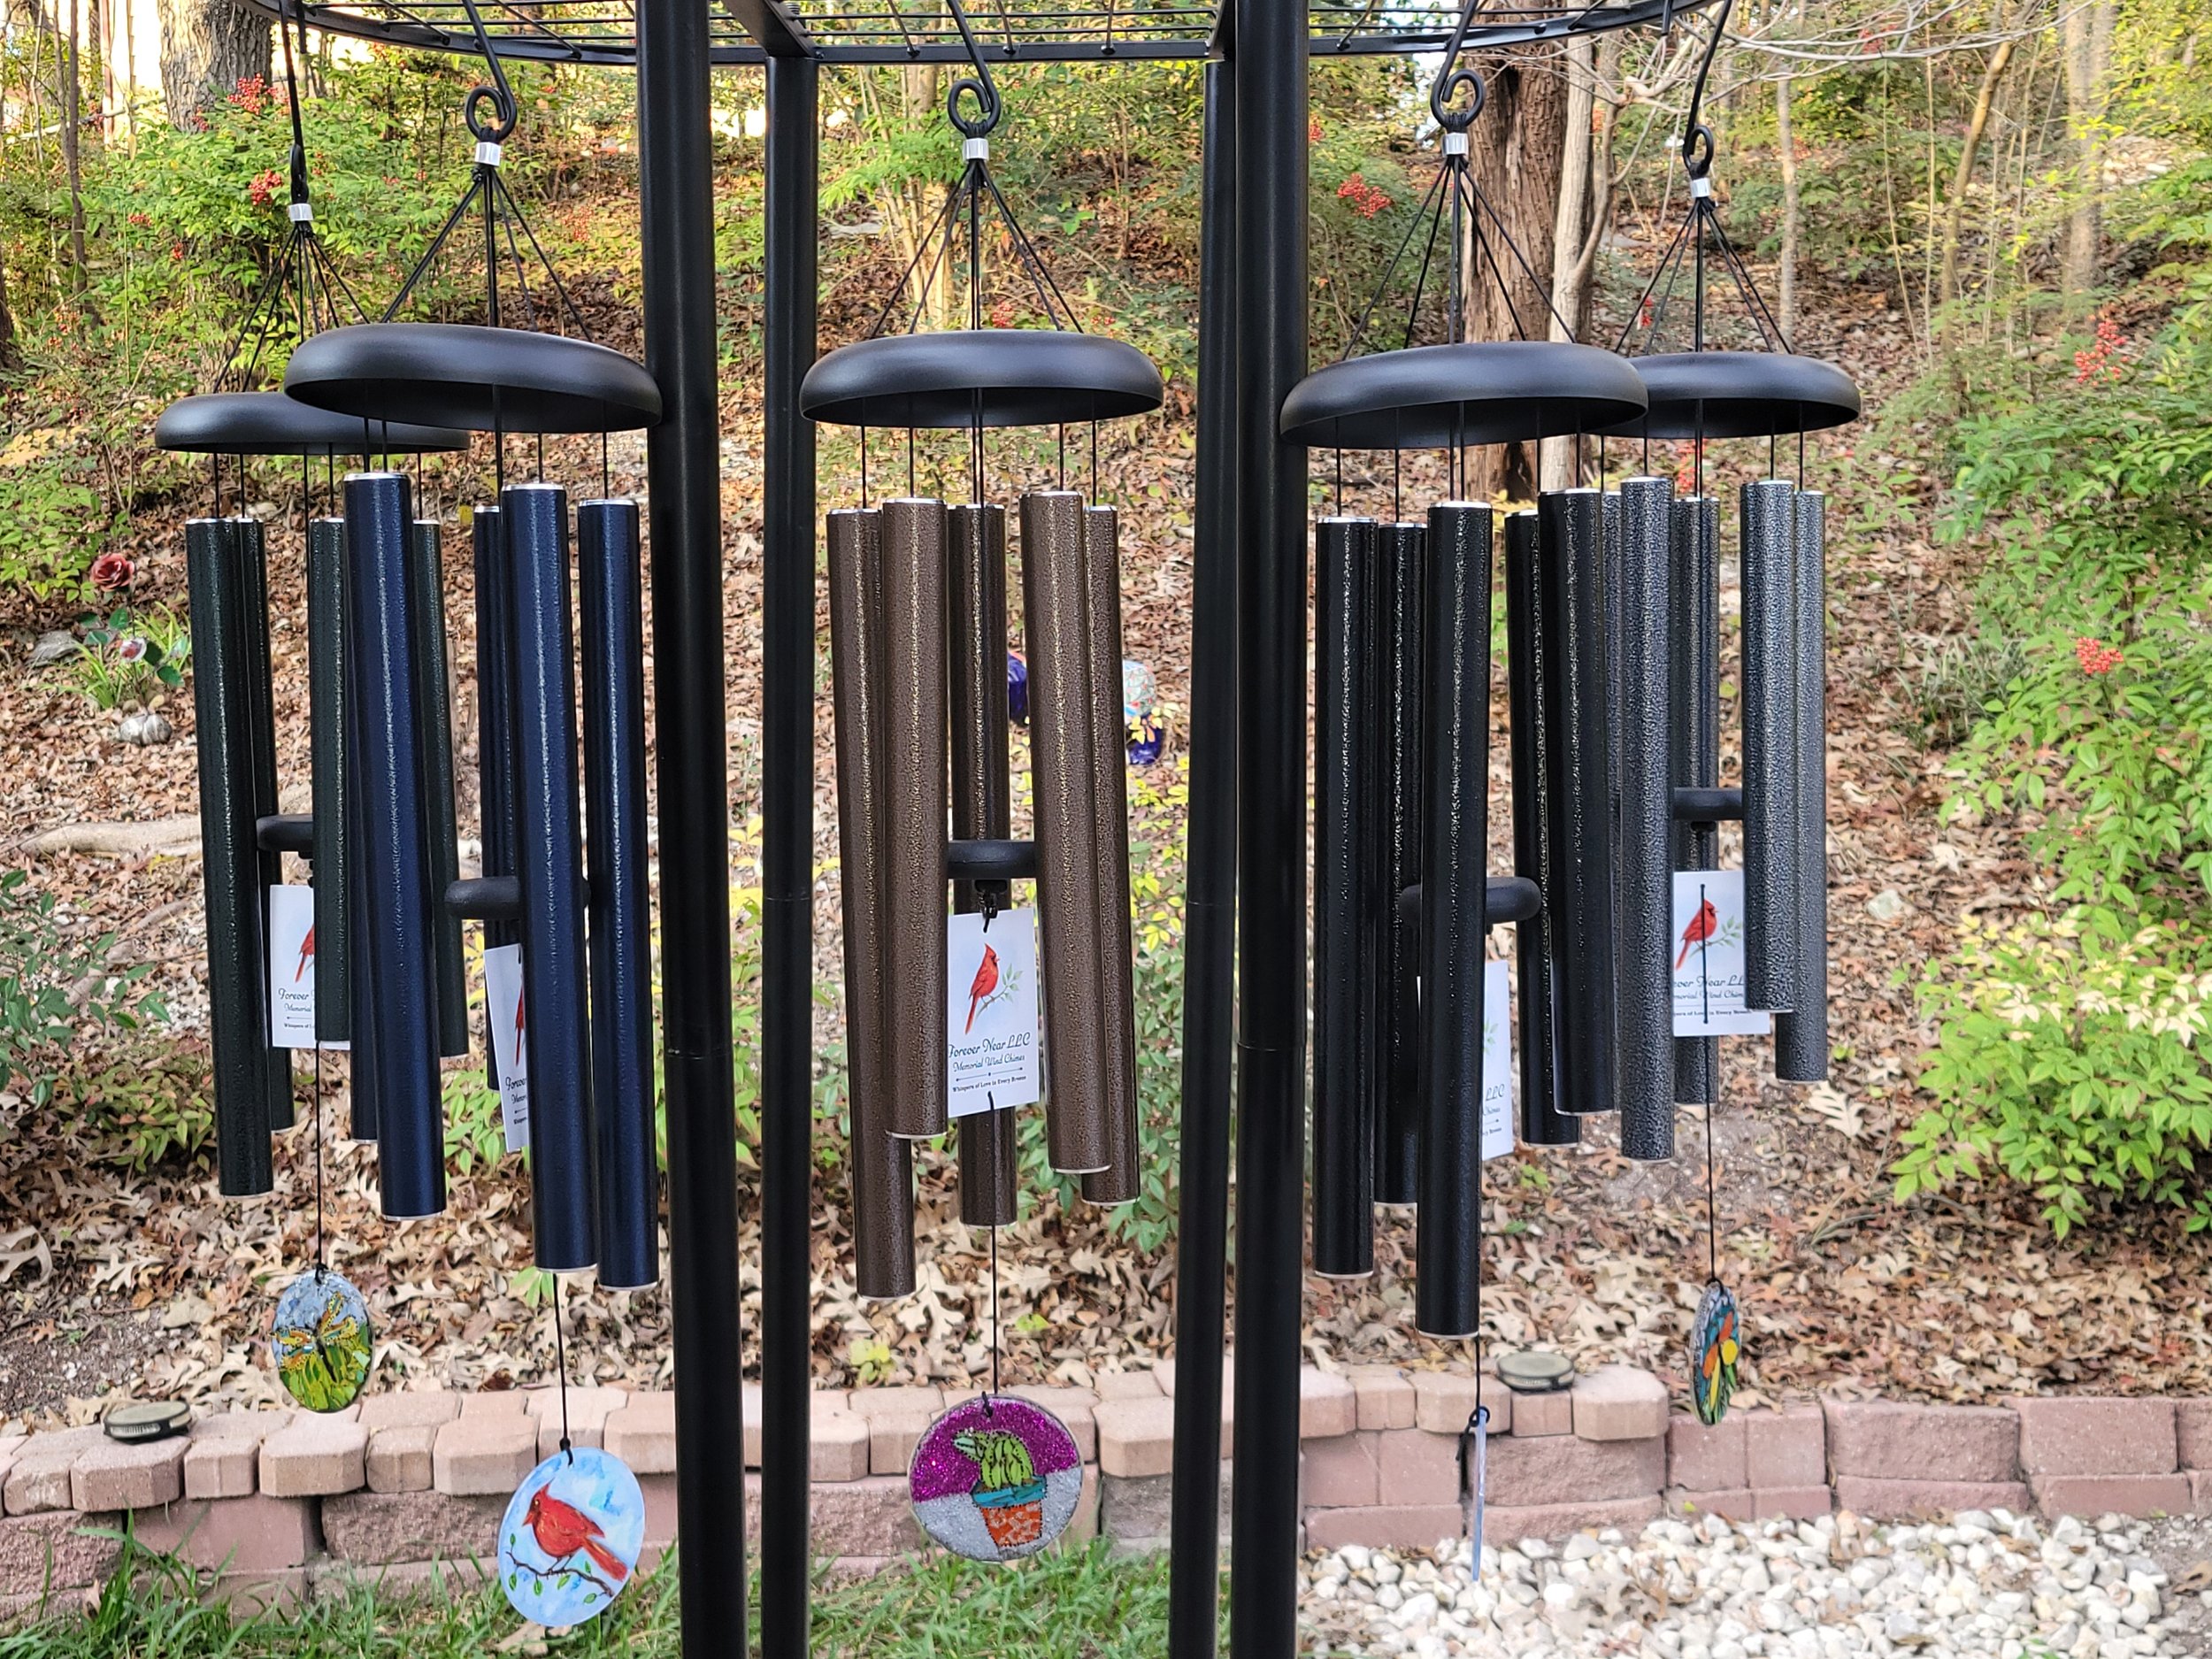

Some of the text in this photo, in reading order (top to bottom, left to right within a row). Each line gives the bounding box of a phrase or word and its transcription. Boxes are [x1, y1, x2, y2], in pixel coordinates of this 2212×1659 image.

[1727, 974, 1745, 987] LL
[278, 987, 310, 1001] Forever
[982, 1037, 1006, 1053] Near
[1007, 1032, 1031, 1048] LLC
[953, 1052, 1025, 1072] Memorial Wind Chimes
[1486, 1083, 1505, 1102] LLC
